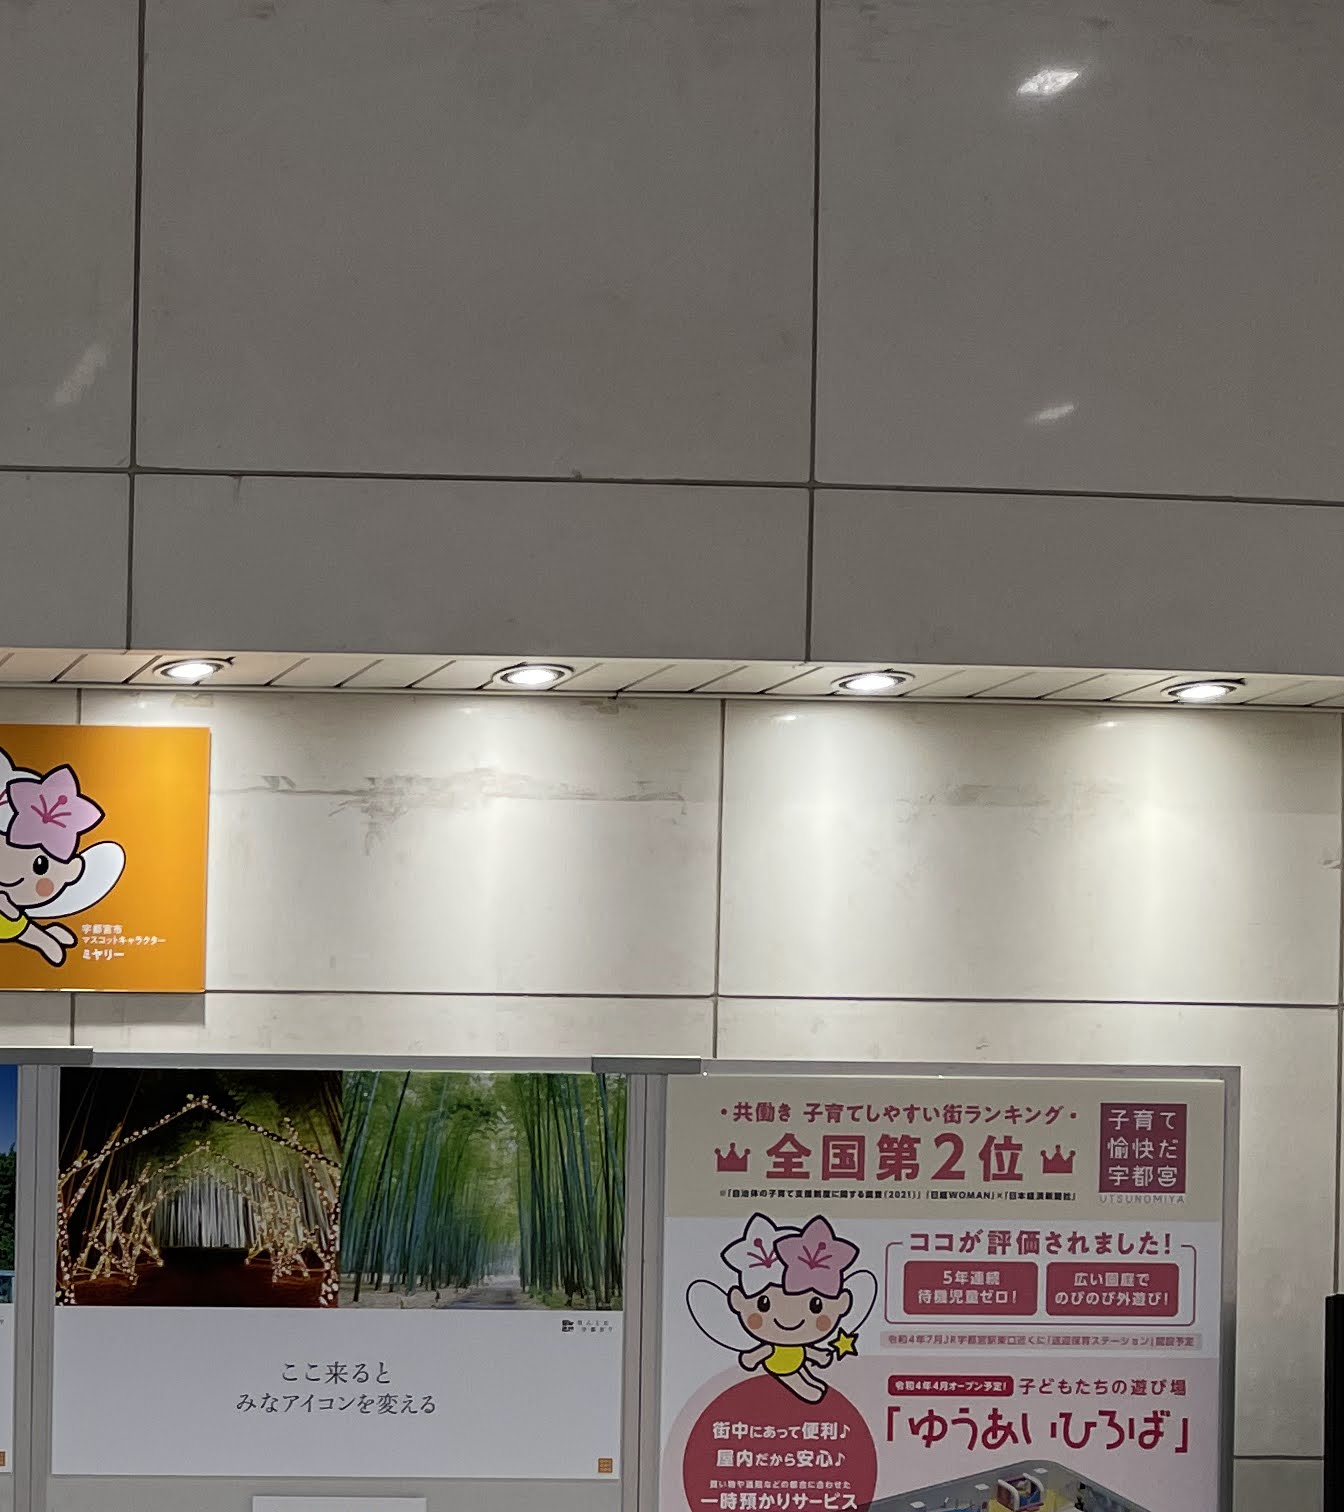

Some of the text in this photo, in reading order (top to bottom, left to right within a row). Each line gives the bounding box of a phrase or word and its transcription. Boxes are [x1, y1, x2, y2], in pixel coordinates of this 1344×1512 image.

[82, 948, 125, 960] ミヤリー
[733, 1101, 1064, 1126] 共働き 子育てしやすい街ランキング
[1107, 1108, 1177, 1132] 子育て
[766, 1131, 1024, 1183] 全国第2位
[1107, 1136, 1179, 1161] 愉快だ
[1107, 1164, 1178, 1188] 宇都宮
[910, 1228, 1172, 1257] ココが評価されました!
[942, 1269, 1001, 1287] 5年連続
[917, 1288, 1018, 1307] 待機児童ゼロ!
[1054, 1289, 1170, 1308] のびのび外遊び!
[281, 1361, 393, 1386] ここ来ると
[1018, 1377, 1188, 1397] 子どもたちの遊び場
[235, 1393, 438, 1416] みなアイコンを変える
[886, 1405, 1190, 1454] 「ゆうあいひろば」
[701, 1492, 858, 1511] 一時預かりサービス
